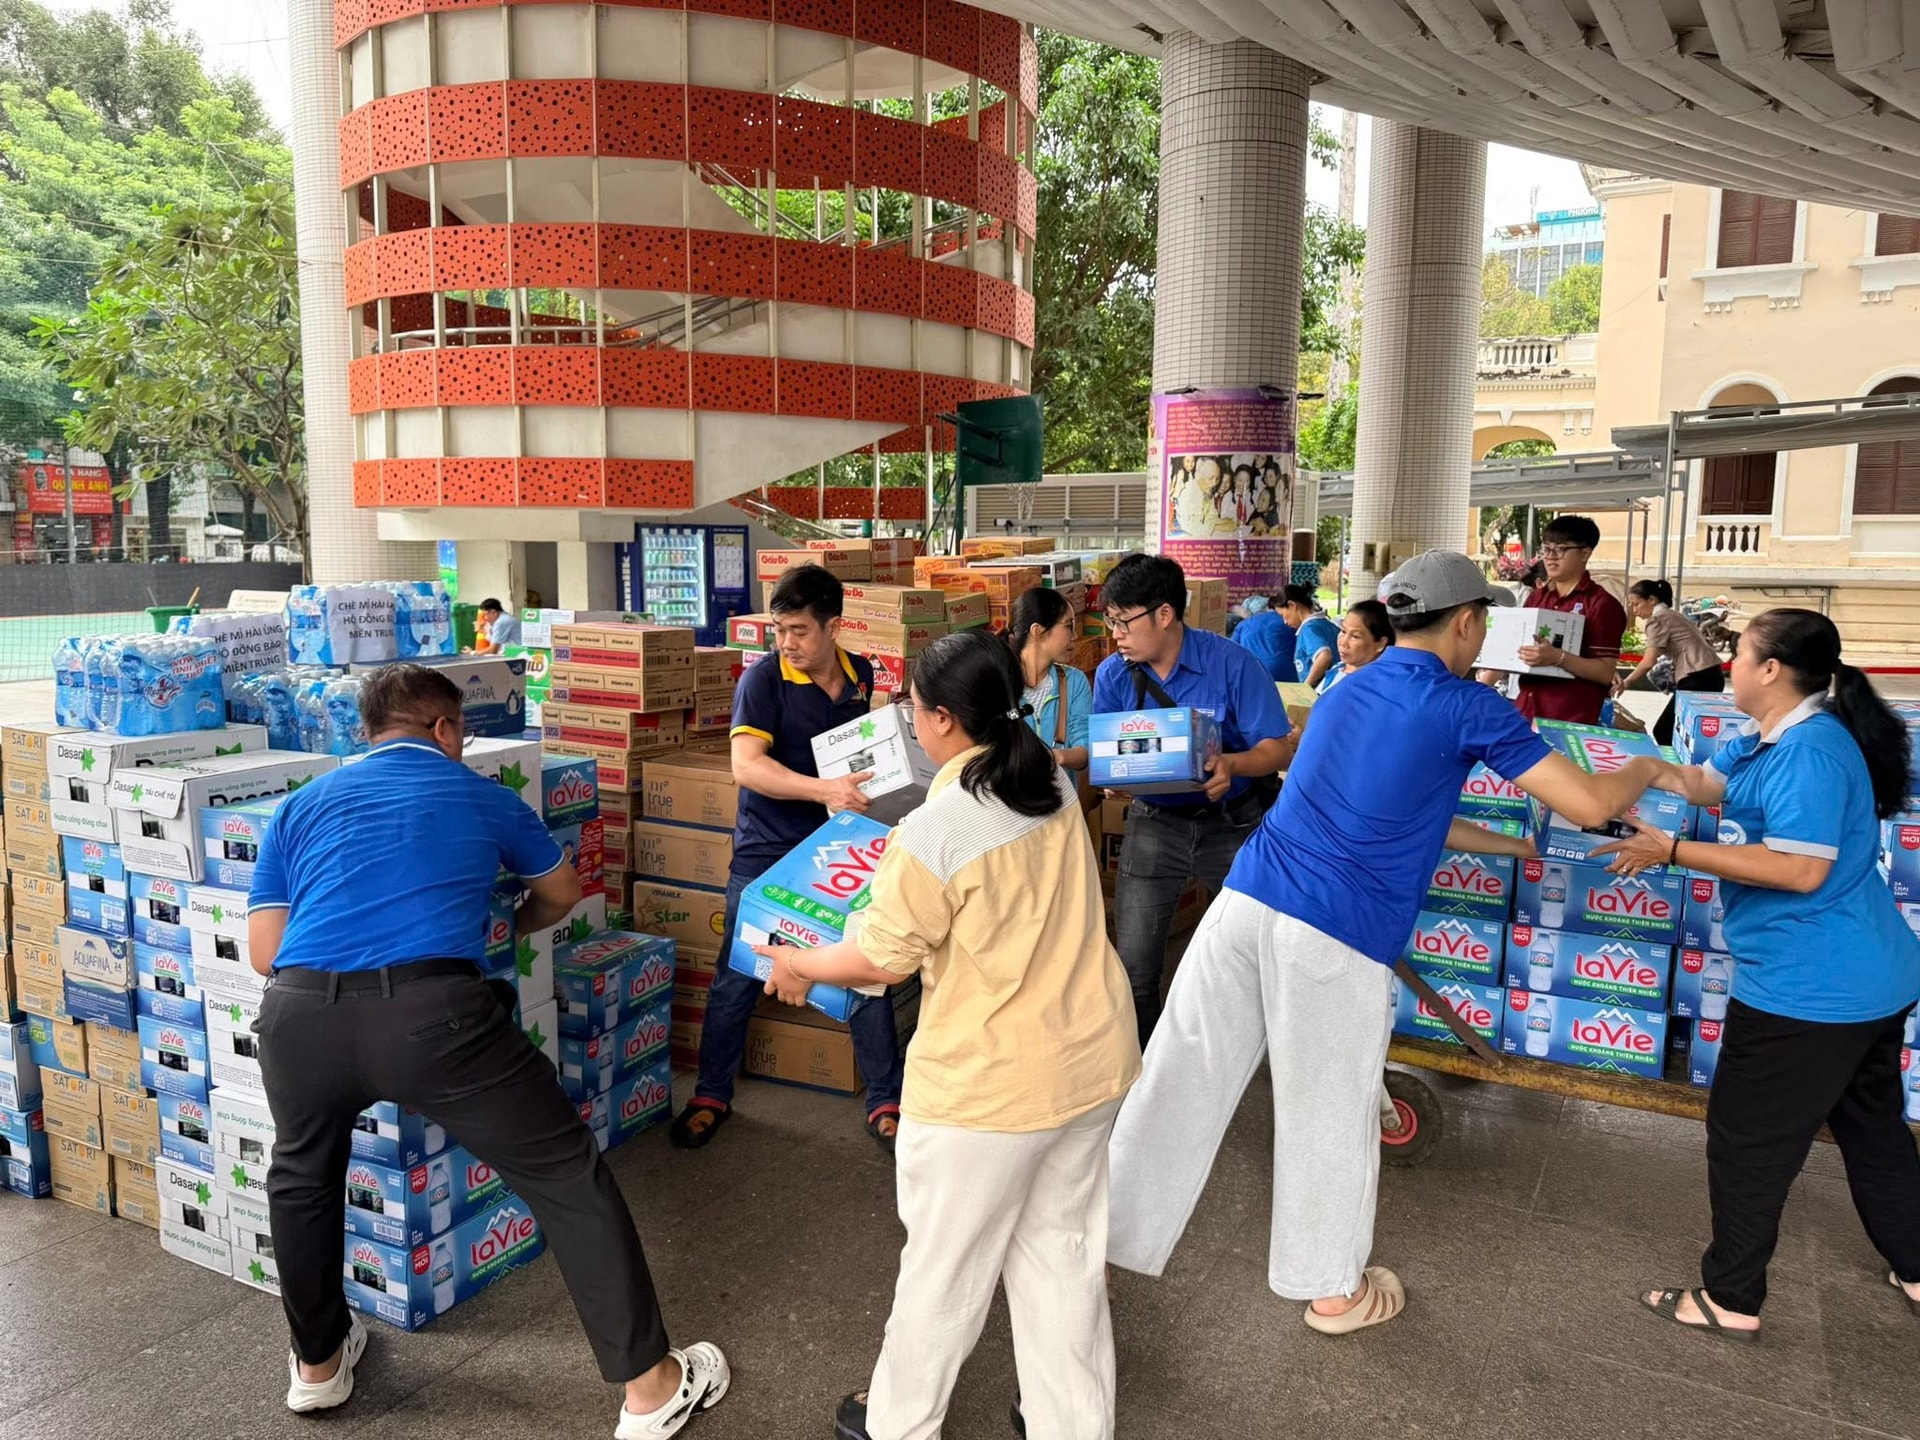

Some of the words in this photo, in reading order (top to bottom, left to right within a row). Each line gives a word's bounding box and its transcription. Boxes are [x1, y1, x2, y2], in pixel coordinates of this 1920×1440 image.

[52, 479, 86, 492] QUNH
[214, 631, 228, 644] HÈ
[248, 655, 281, 669] TRUNG
[527, 660, 544, 672] ILO
[460, 687, 496, 704] QUAFINA
[12, 733, 42, 749] SATORI
[1584, 738, 1627, 773] laVi
[648, 793, 673, 807] true
[16, 806, 47, 823] SATORI
[641, 850, 666, 864] true
[22, 877, 54, 895] SATORI
[1434, 865, 1502, 894] aVie
[654, 909, 690, 923] Star
[24, 948, 57, 966] SATORI
[73, 951, 112, 974] AQUAFINA
[750, 1049, 777, 1064] true
[53, 1074, 88, 1094] SATORI
[113, 1092, 148, 1113] SATORI
[61, 1140, 96, 1160] SATORI
